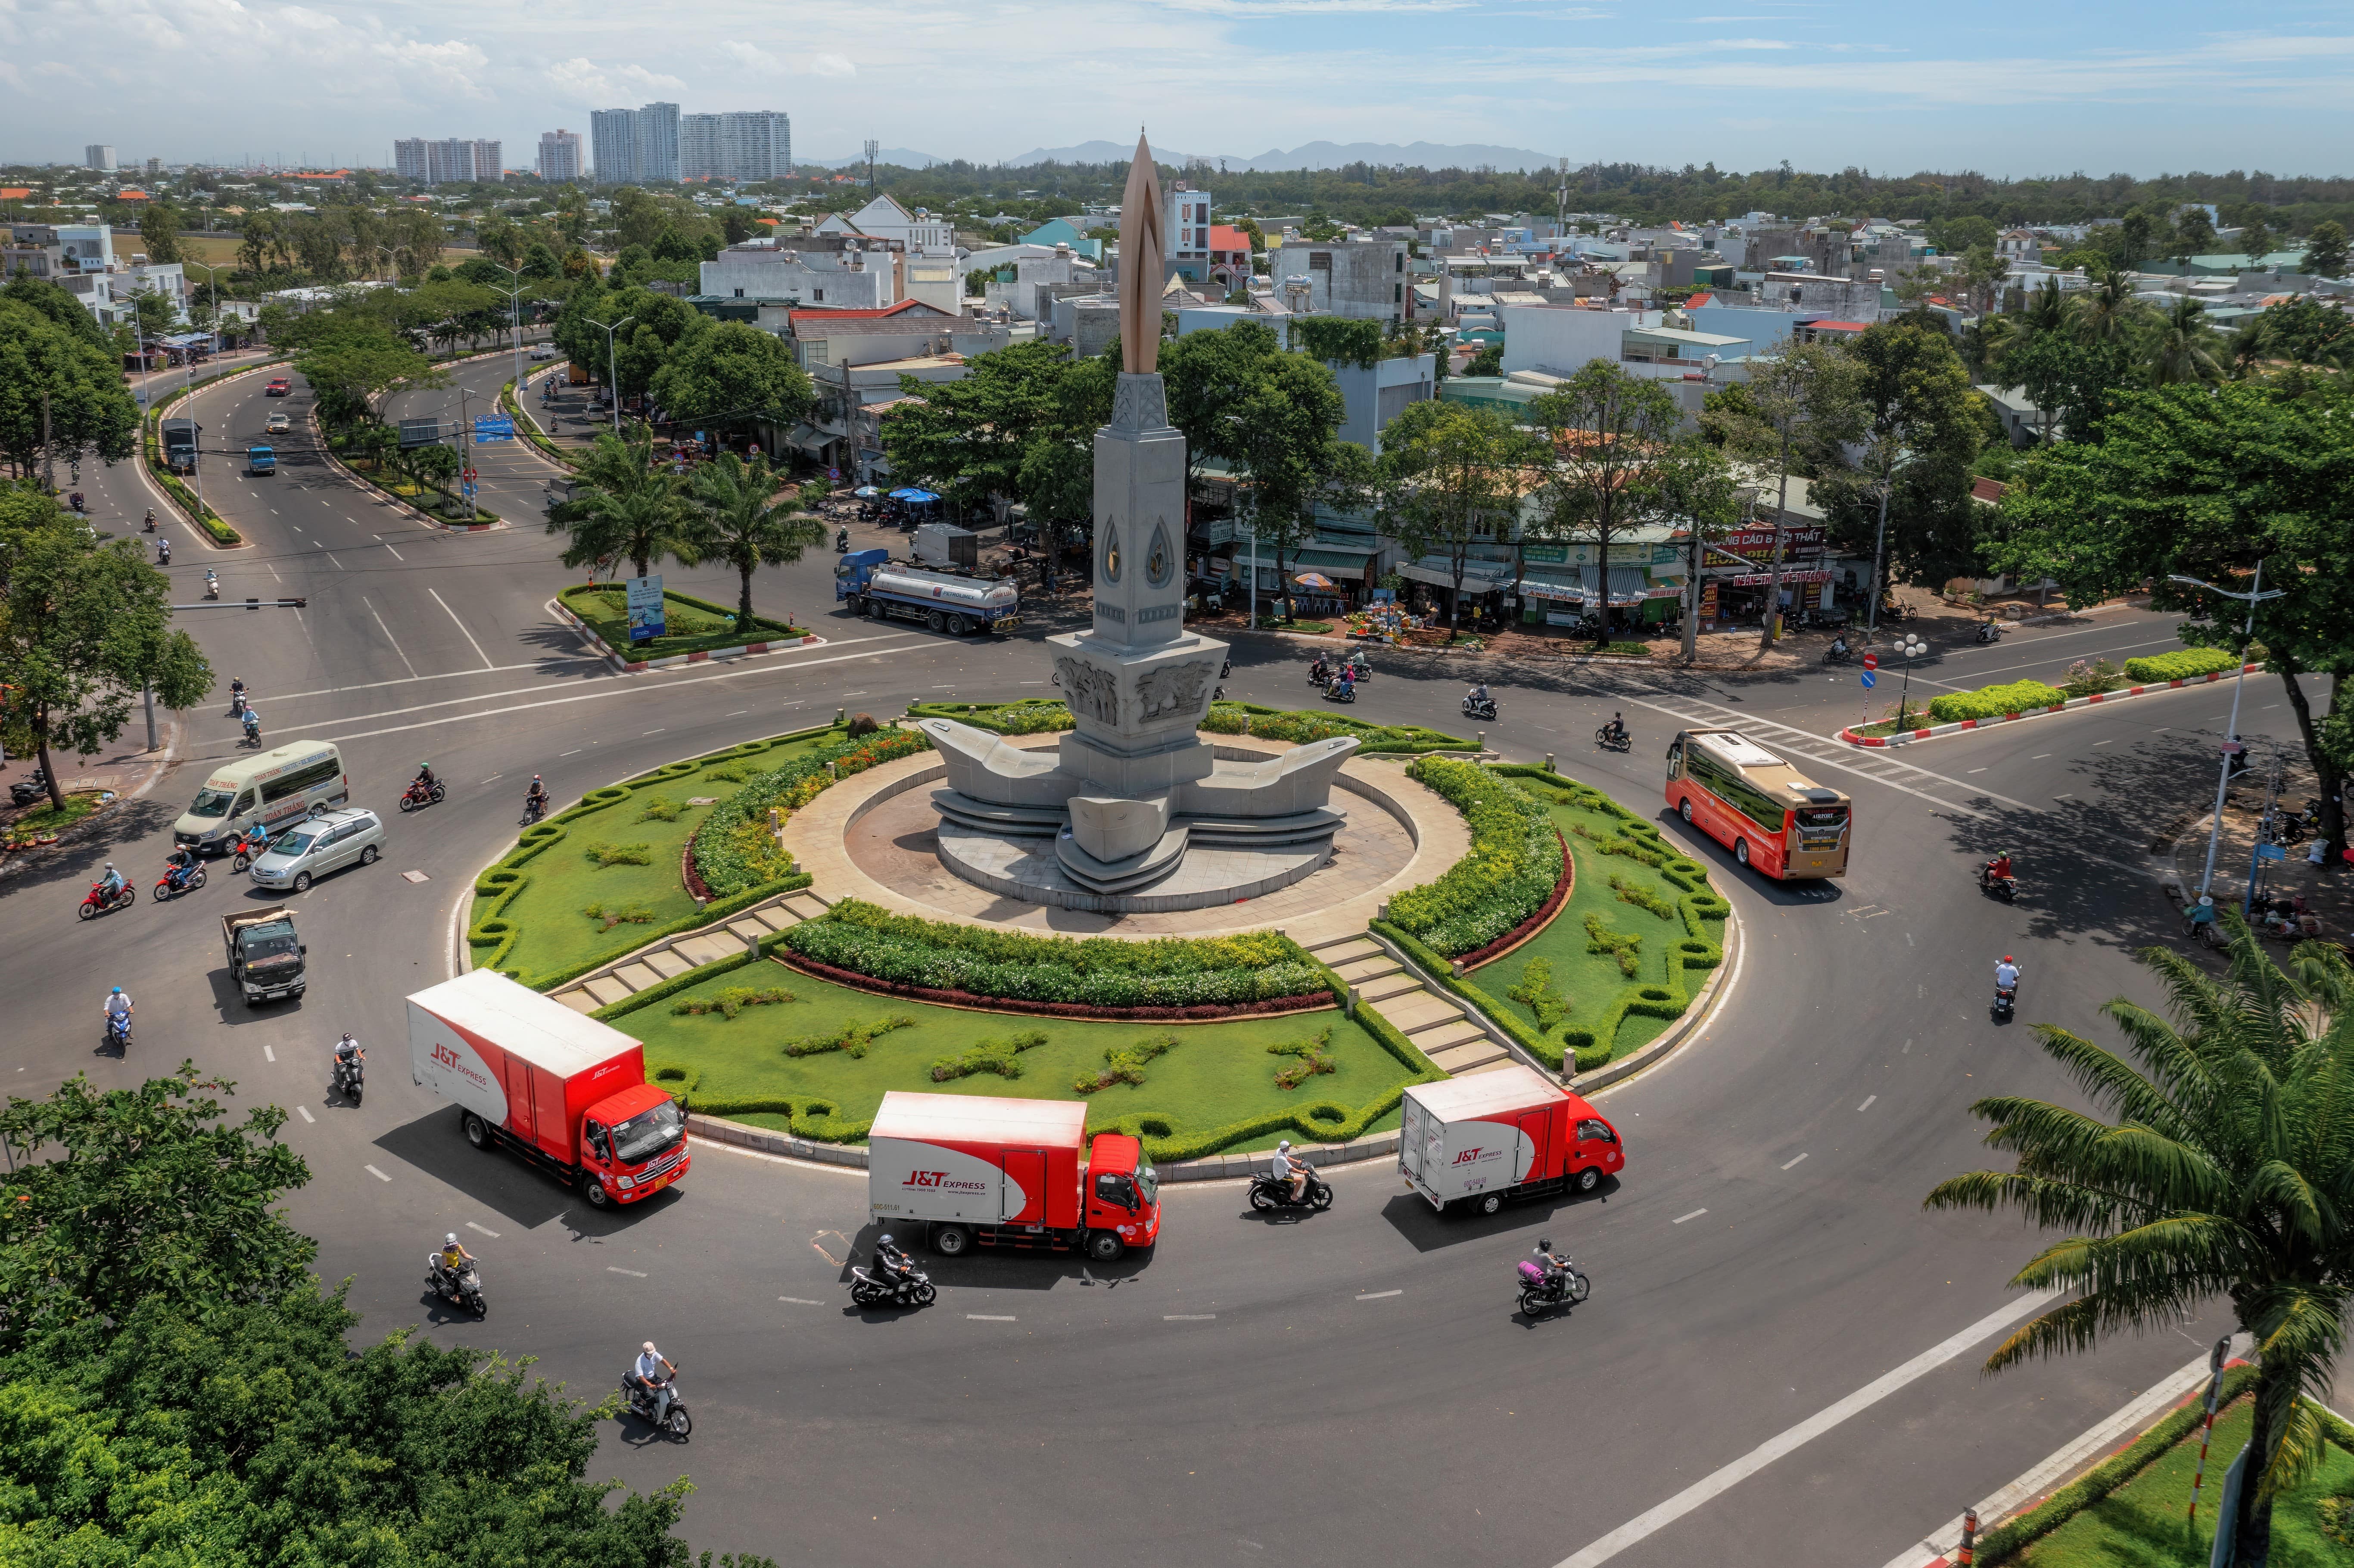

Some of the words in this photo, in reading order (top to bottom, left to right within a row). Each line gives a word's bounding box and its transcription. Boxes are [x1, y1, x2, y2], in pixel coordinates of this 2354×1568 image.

[1742, 533, 1763, 544] CÁO
[1795, 528, 1821, 542] THẤT
[943, 591, 975, 600] PETROLIMEX
[264, 809, 281, 821] TOÀN
[283, 800, 305, 814] THẮNG
[431, 1043, 461, 1068] J&T
[458, 1064, 486, 1085] EXPRESS
[592, 1067, 608, 1080] J&T
[645, 1156, 661, 1170] J&T
[1451, 1147, 1484, 1164] J&T
[1478, 1150, 1502, 1159] EXPRESS
[902, 1170, 951, 1186] J&T
[943, 1181, 985, 1189] EXPRESS
